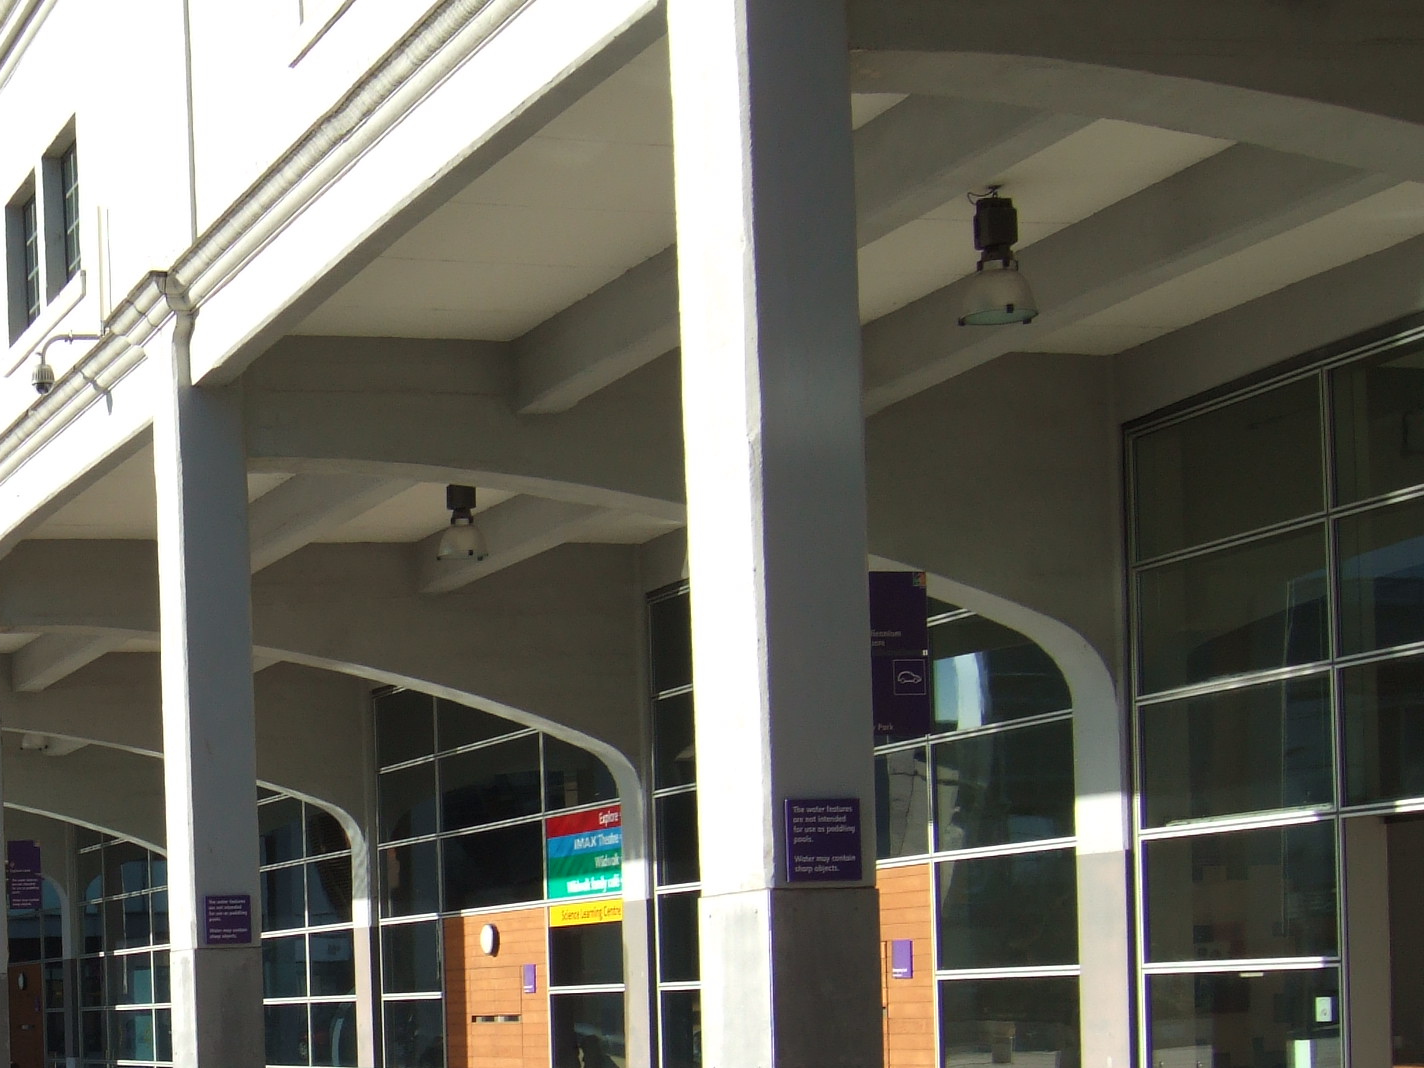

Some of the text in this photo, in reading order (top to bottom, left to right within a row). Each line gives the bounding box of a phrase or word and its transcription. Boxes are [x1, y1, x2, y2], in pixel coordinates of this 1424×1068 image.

[793, 805, 805, 813] The
[826, 805, 853, 813] features
[598, 810, 619, 828] Explore
[805, 815, 816, 823] not
[817, 815, 847, 823] intended
[793, 825, 803, 833] for
[826, 825, 856, 834] paddling
[573, 832, 619, 850] IMAX Theatre
[816, 856, 830, 864] may
[831, 854, 856, 862] contain
[795, 865, 813, 874] sharp
[561, 905, 622, 921] Science Learning Centre
